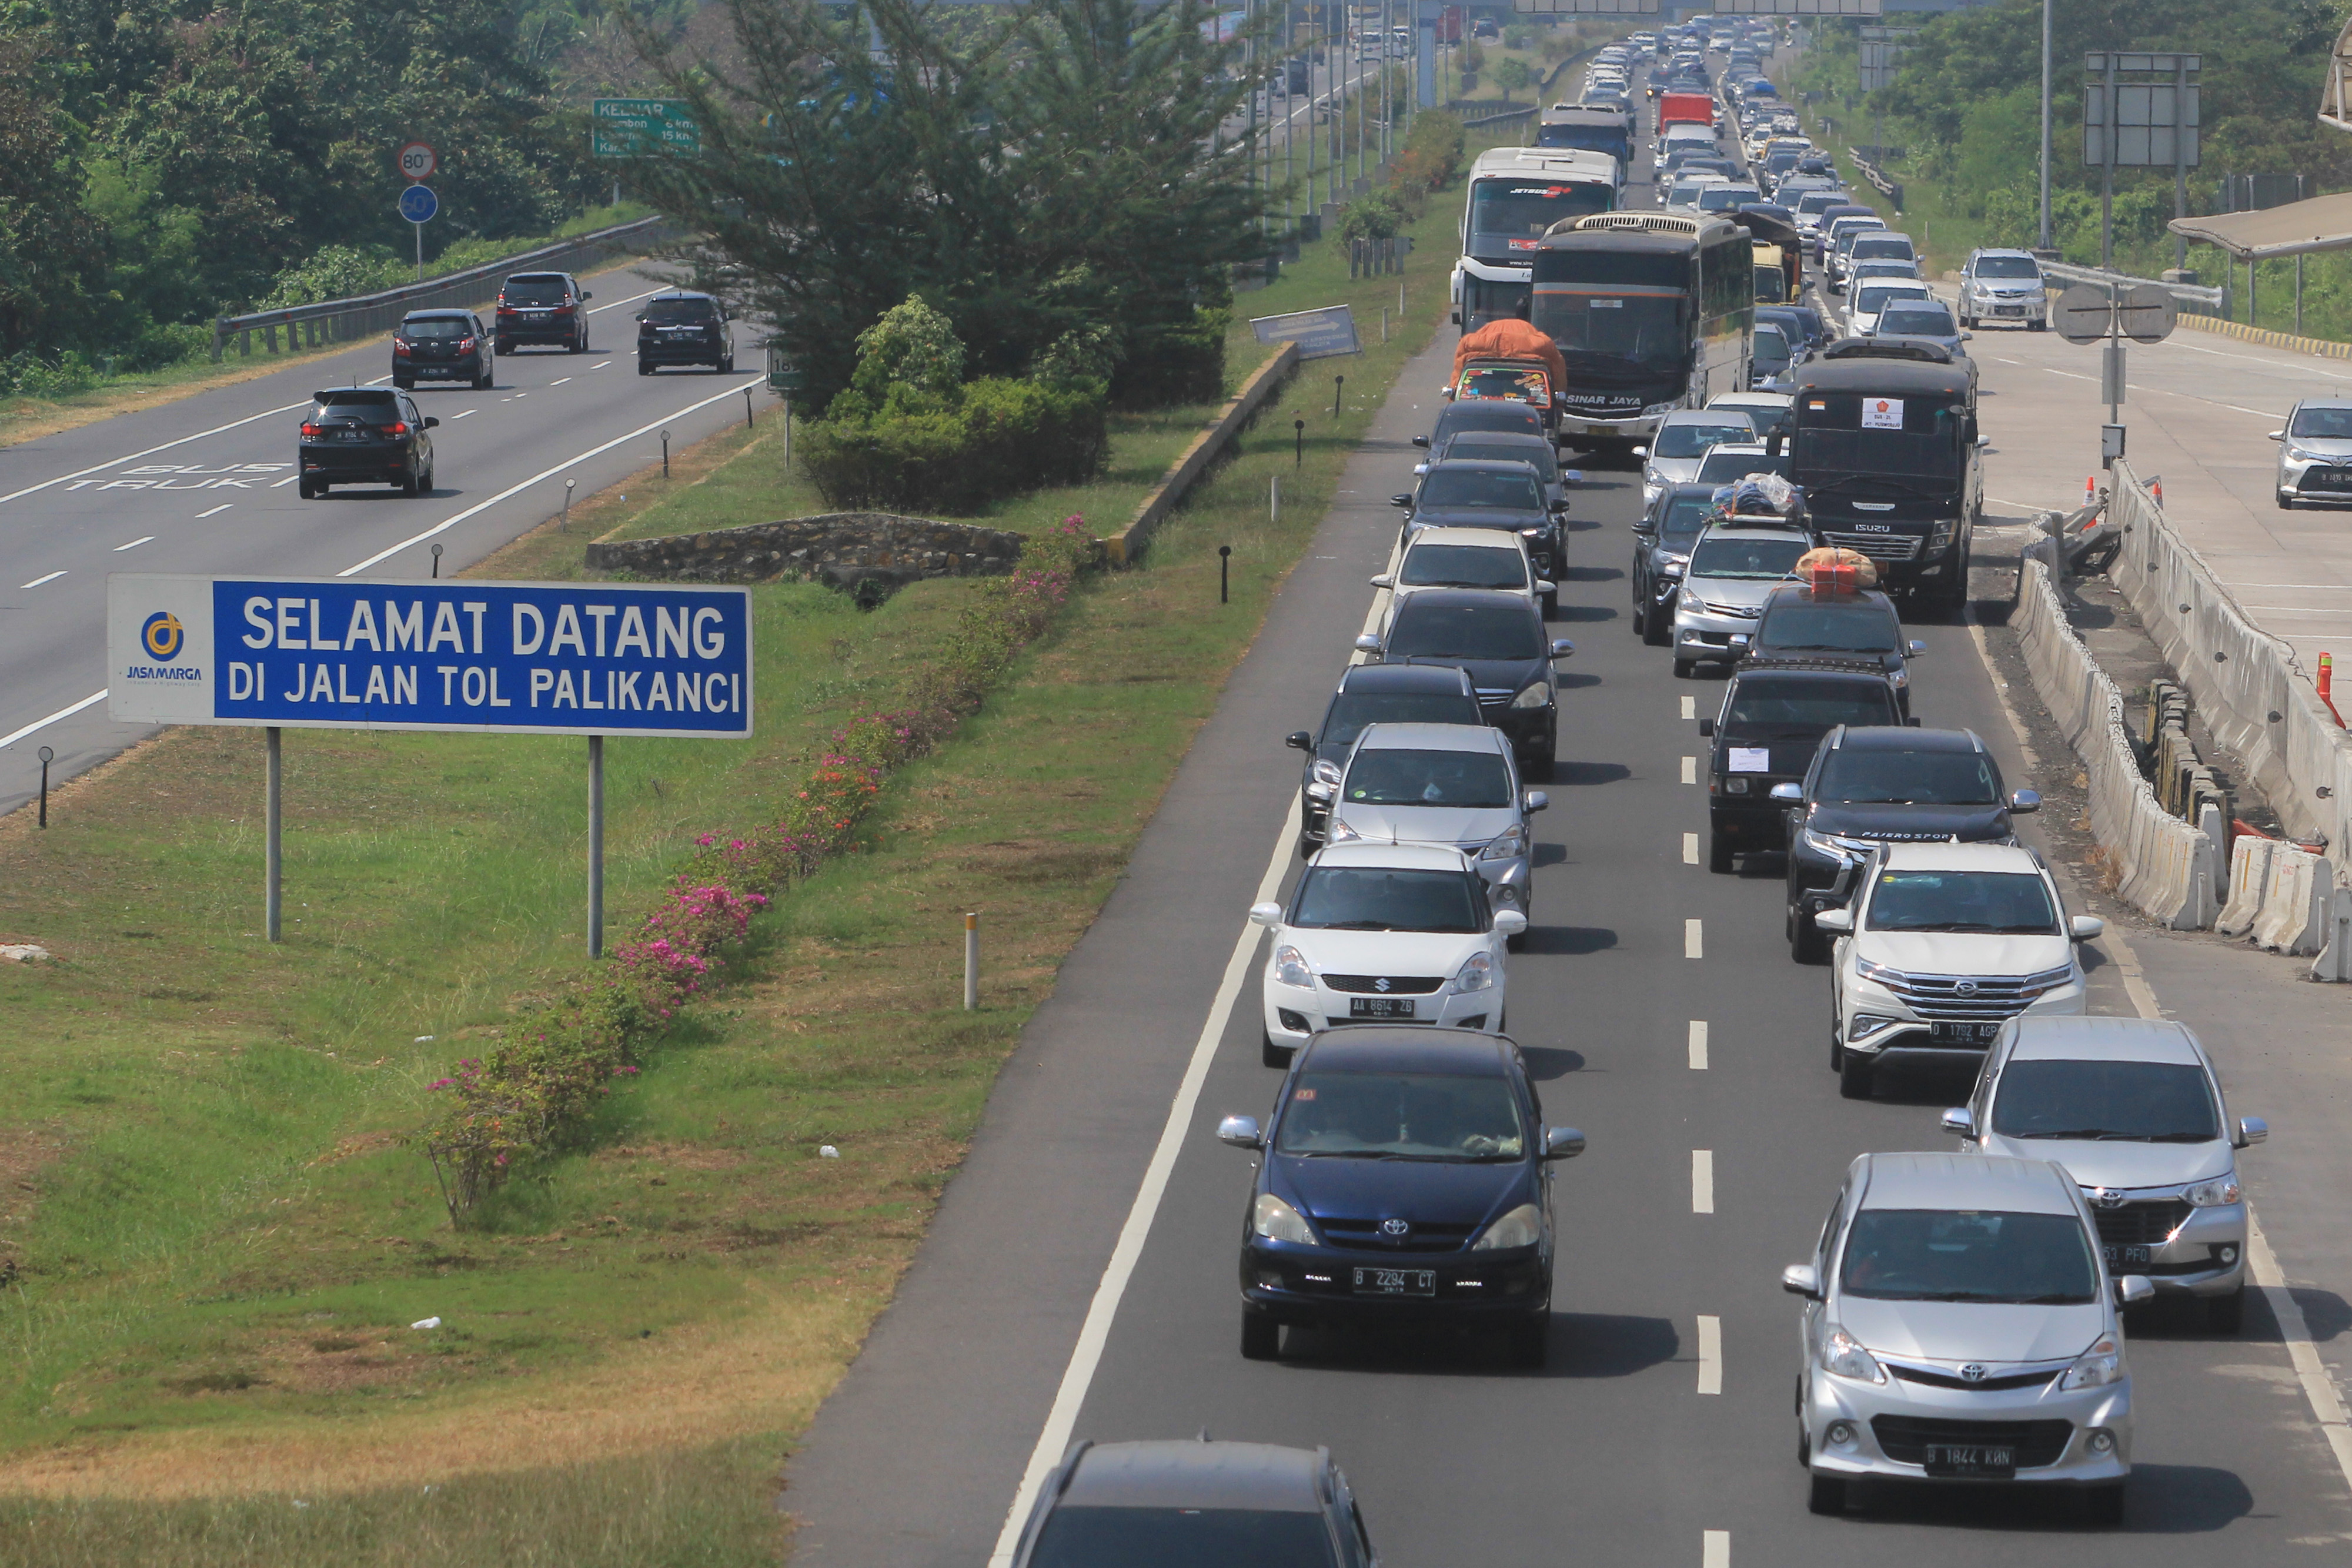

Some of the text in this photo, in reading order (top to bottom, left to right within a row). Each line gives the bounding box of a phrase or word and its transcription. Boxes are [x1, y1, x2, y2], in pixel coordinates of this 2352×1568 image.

[662, 131, 673, 140] 15
[403, 154, 423, 169] 80
[1566, 394, 1641, 405] SINAR JAYA
[119, 462, 293, 475] BUS
[65, 477, 269, 491] TRUK
[1855, 524, 1890, 532] ISUZU
[241, 596, 725, 660] SELAMAT DATANG
[228, 661, 739, 713] DI JALAN TOL PALIKANCI
[1354, 999, 1412, 1012] AA 8614 ZB
[1933, 1024, 1997, 1037] D 1792 AGP
[1355, 1271, 1433, 1288] B 2294 CT
[1927, 1448, 1936, 1463] B
[1947, 1448, 1977, 1464] 1844
